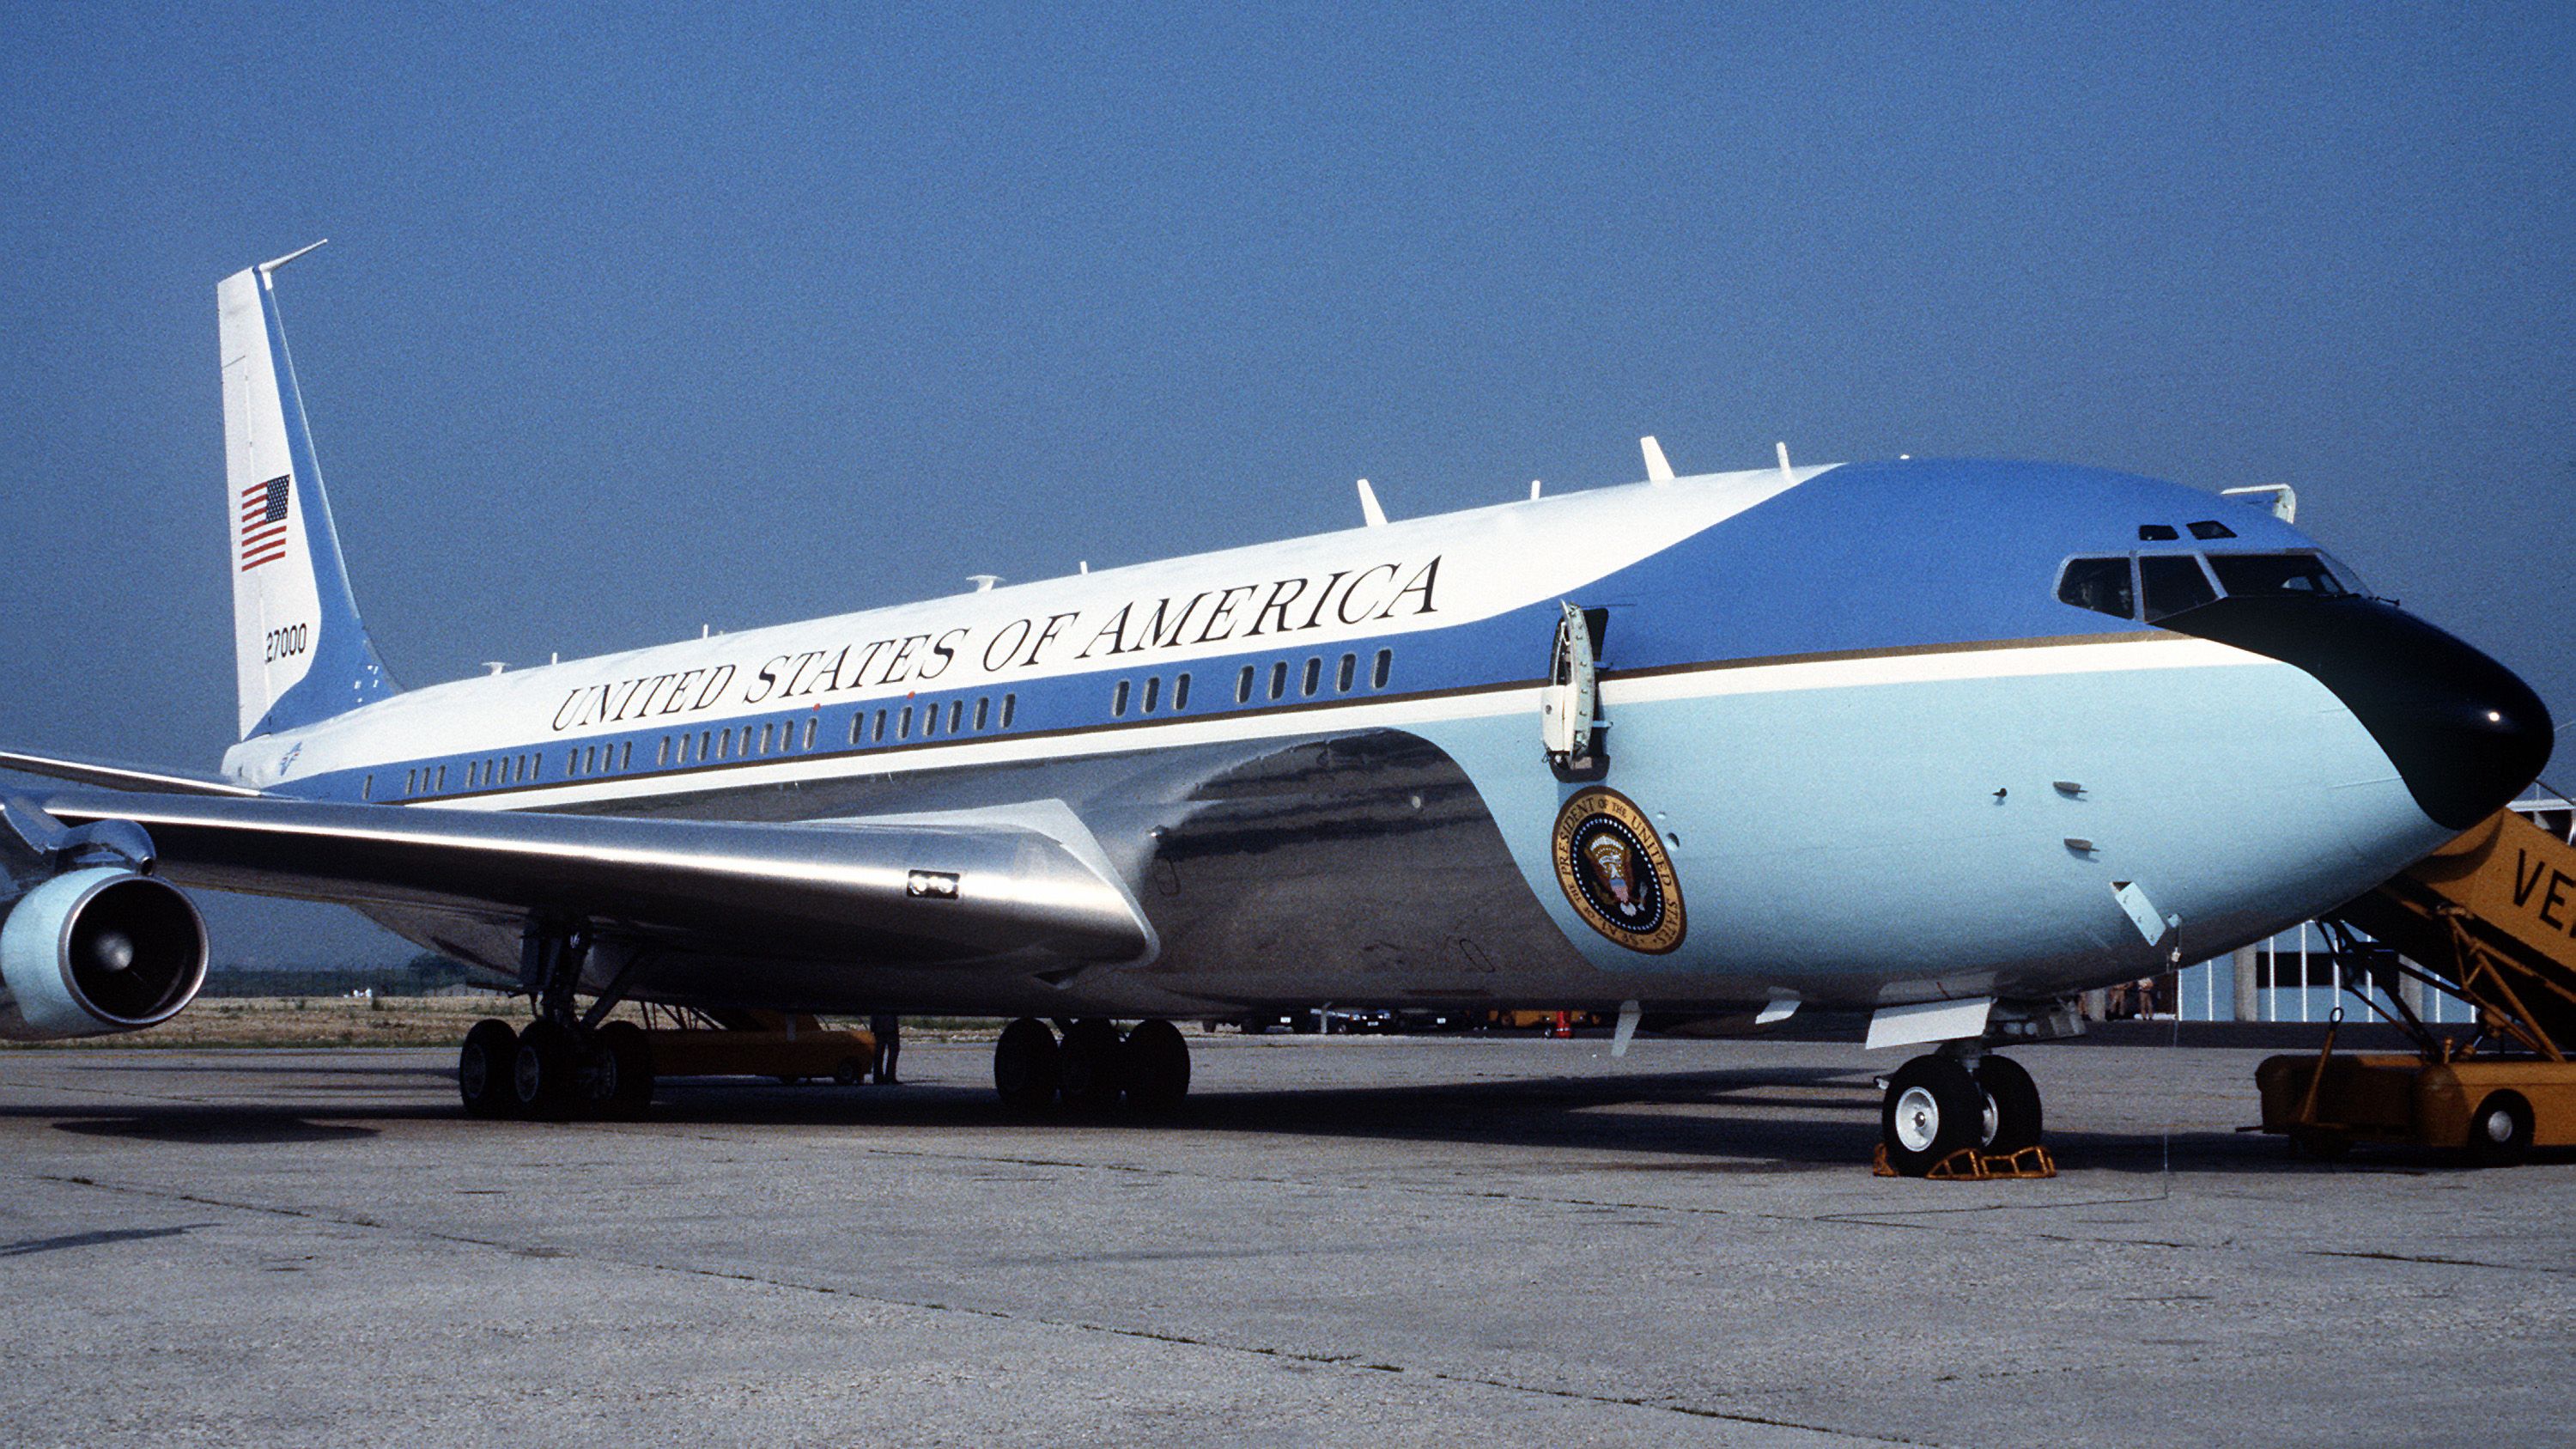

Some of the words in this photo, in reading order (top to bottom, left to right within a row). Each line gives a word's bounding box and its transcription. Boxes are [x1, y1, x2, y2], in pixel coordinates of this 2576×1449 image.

[266, 623, 307, 662] 27000
[551, 663, 736, 732] UNITED
[744, 628, 971, 703] STATES
[983, 611, 1081, 673] OF
[1075, 554, 1443, 660] AMERICA
[1559, 797, 1595, 875] PRESIDENT
[1598, 799, 1608, 809] OF
[1612, 802, 1628, 819] THE
[1631, 817, 1672, 886] UNITED
[1656, 898, 1679, 944] STATES
[2513, 849, 2576, 938] VE
